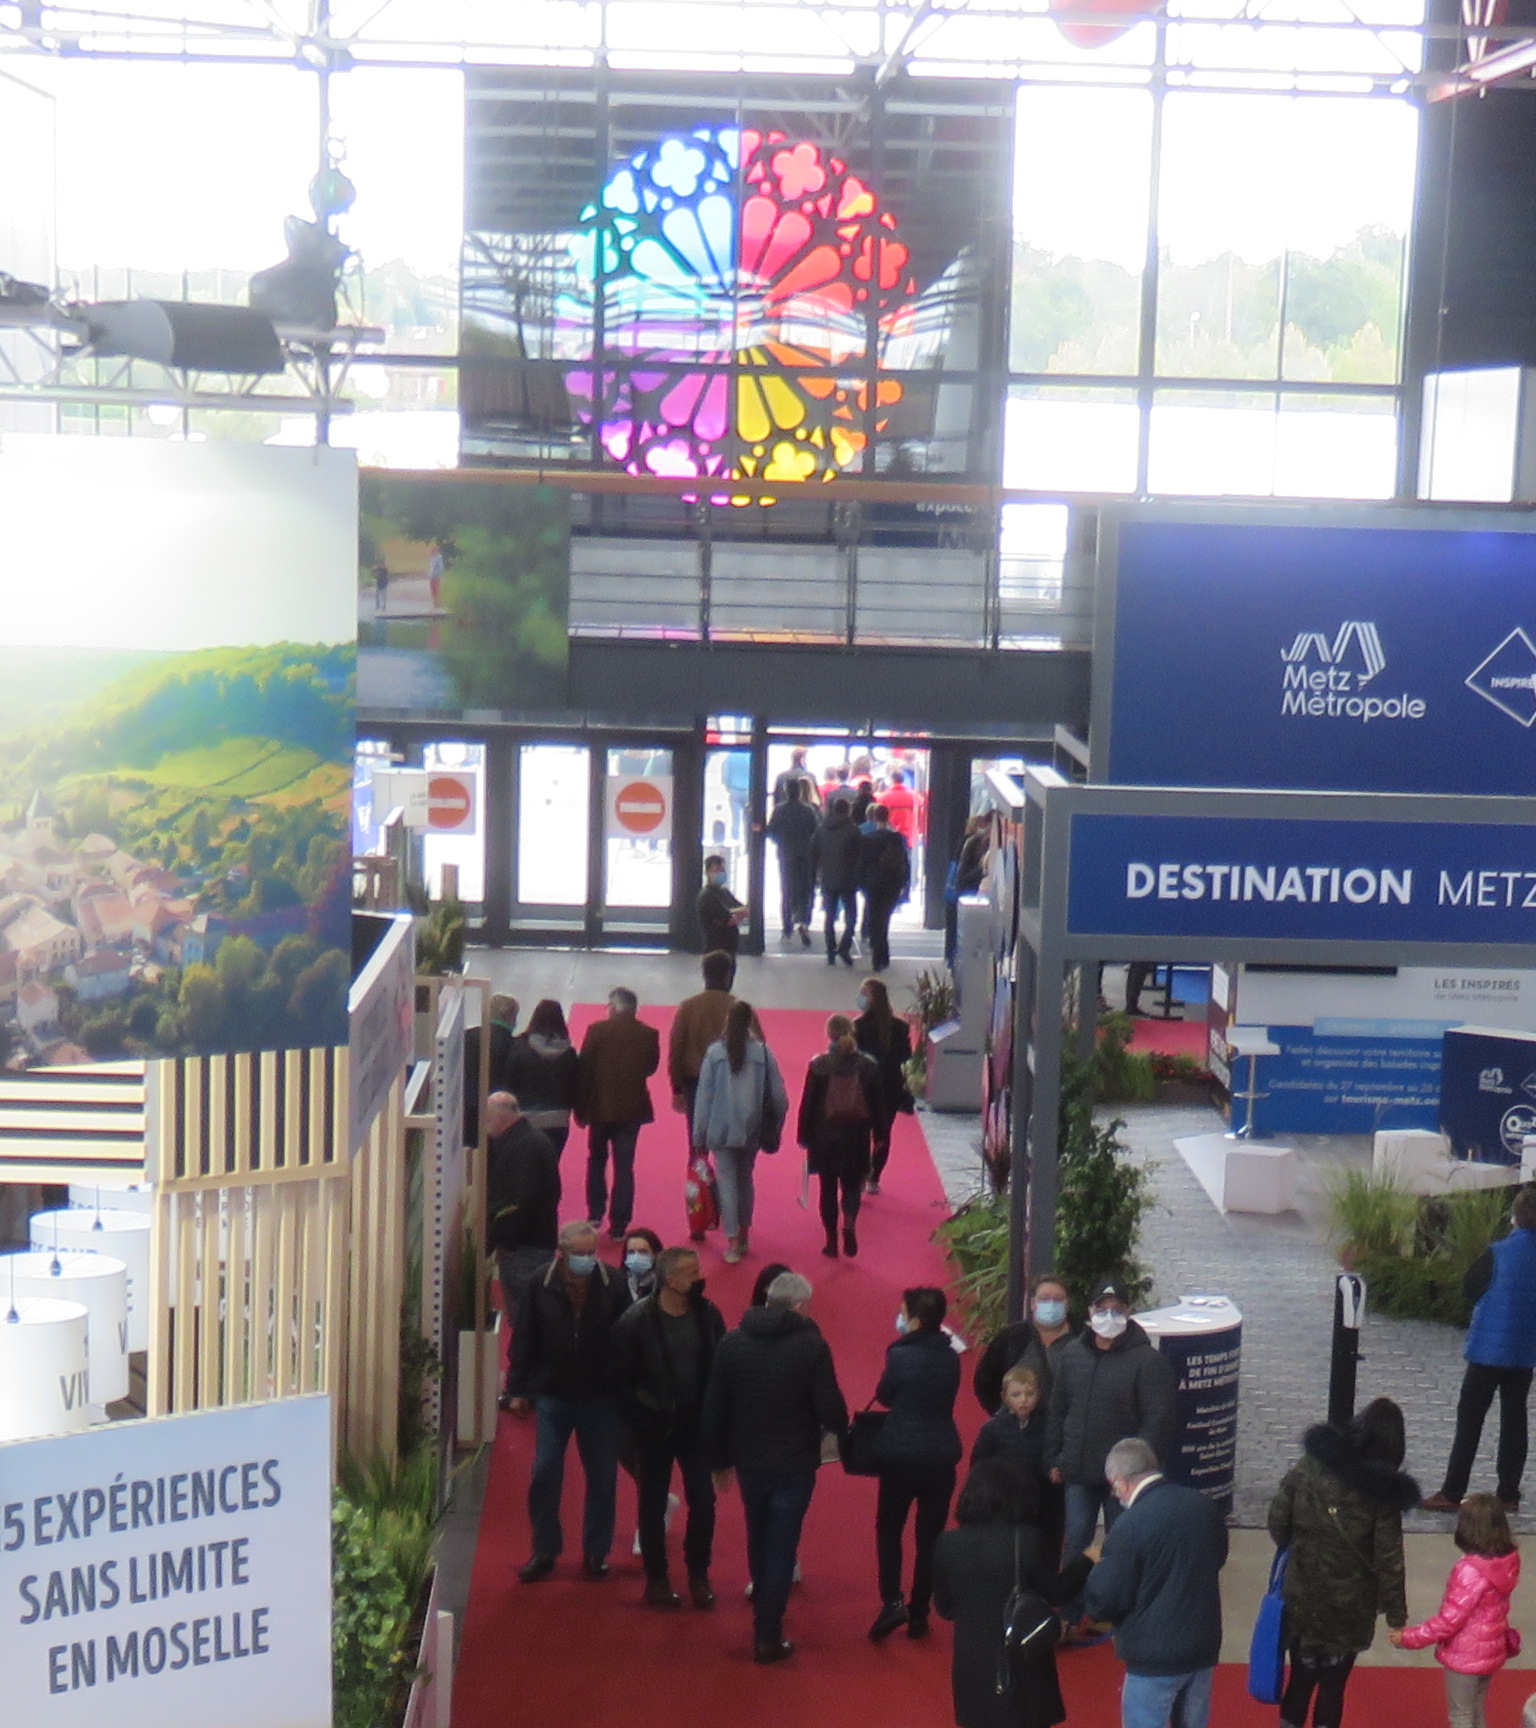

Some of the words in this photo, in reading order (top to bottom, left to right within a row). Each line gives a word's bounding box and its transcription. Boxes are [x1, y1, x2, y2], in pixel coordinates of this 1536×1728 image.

[1282, 664, 1352, 690] Metz
[1280, 690, 1427, 723] Métropole
[1126, 863, 1412, 905] DESTINATION
[1434, 979, 1457, 989] LES
[1460, 979, 1520, 991] INSPIRÉS
[33, 1458, 282, 1546] EXPÉRIENCES
[19, 1560, 120, 1625] SANS
[129, 1537, 250, 1604] LIMITE
[48, 1639, 96, 1695] EN
[106, 1606, 270, 1683] MOSELLE
